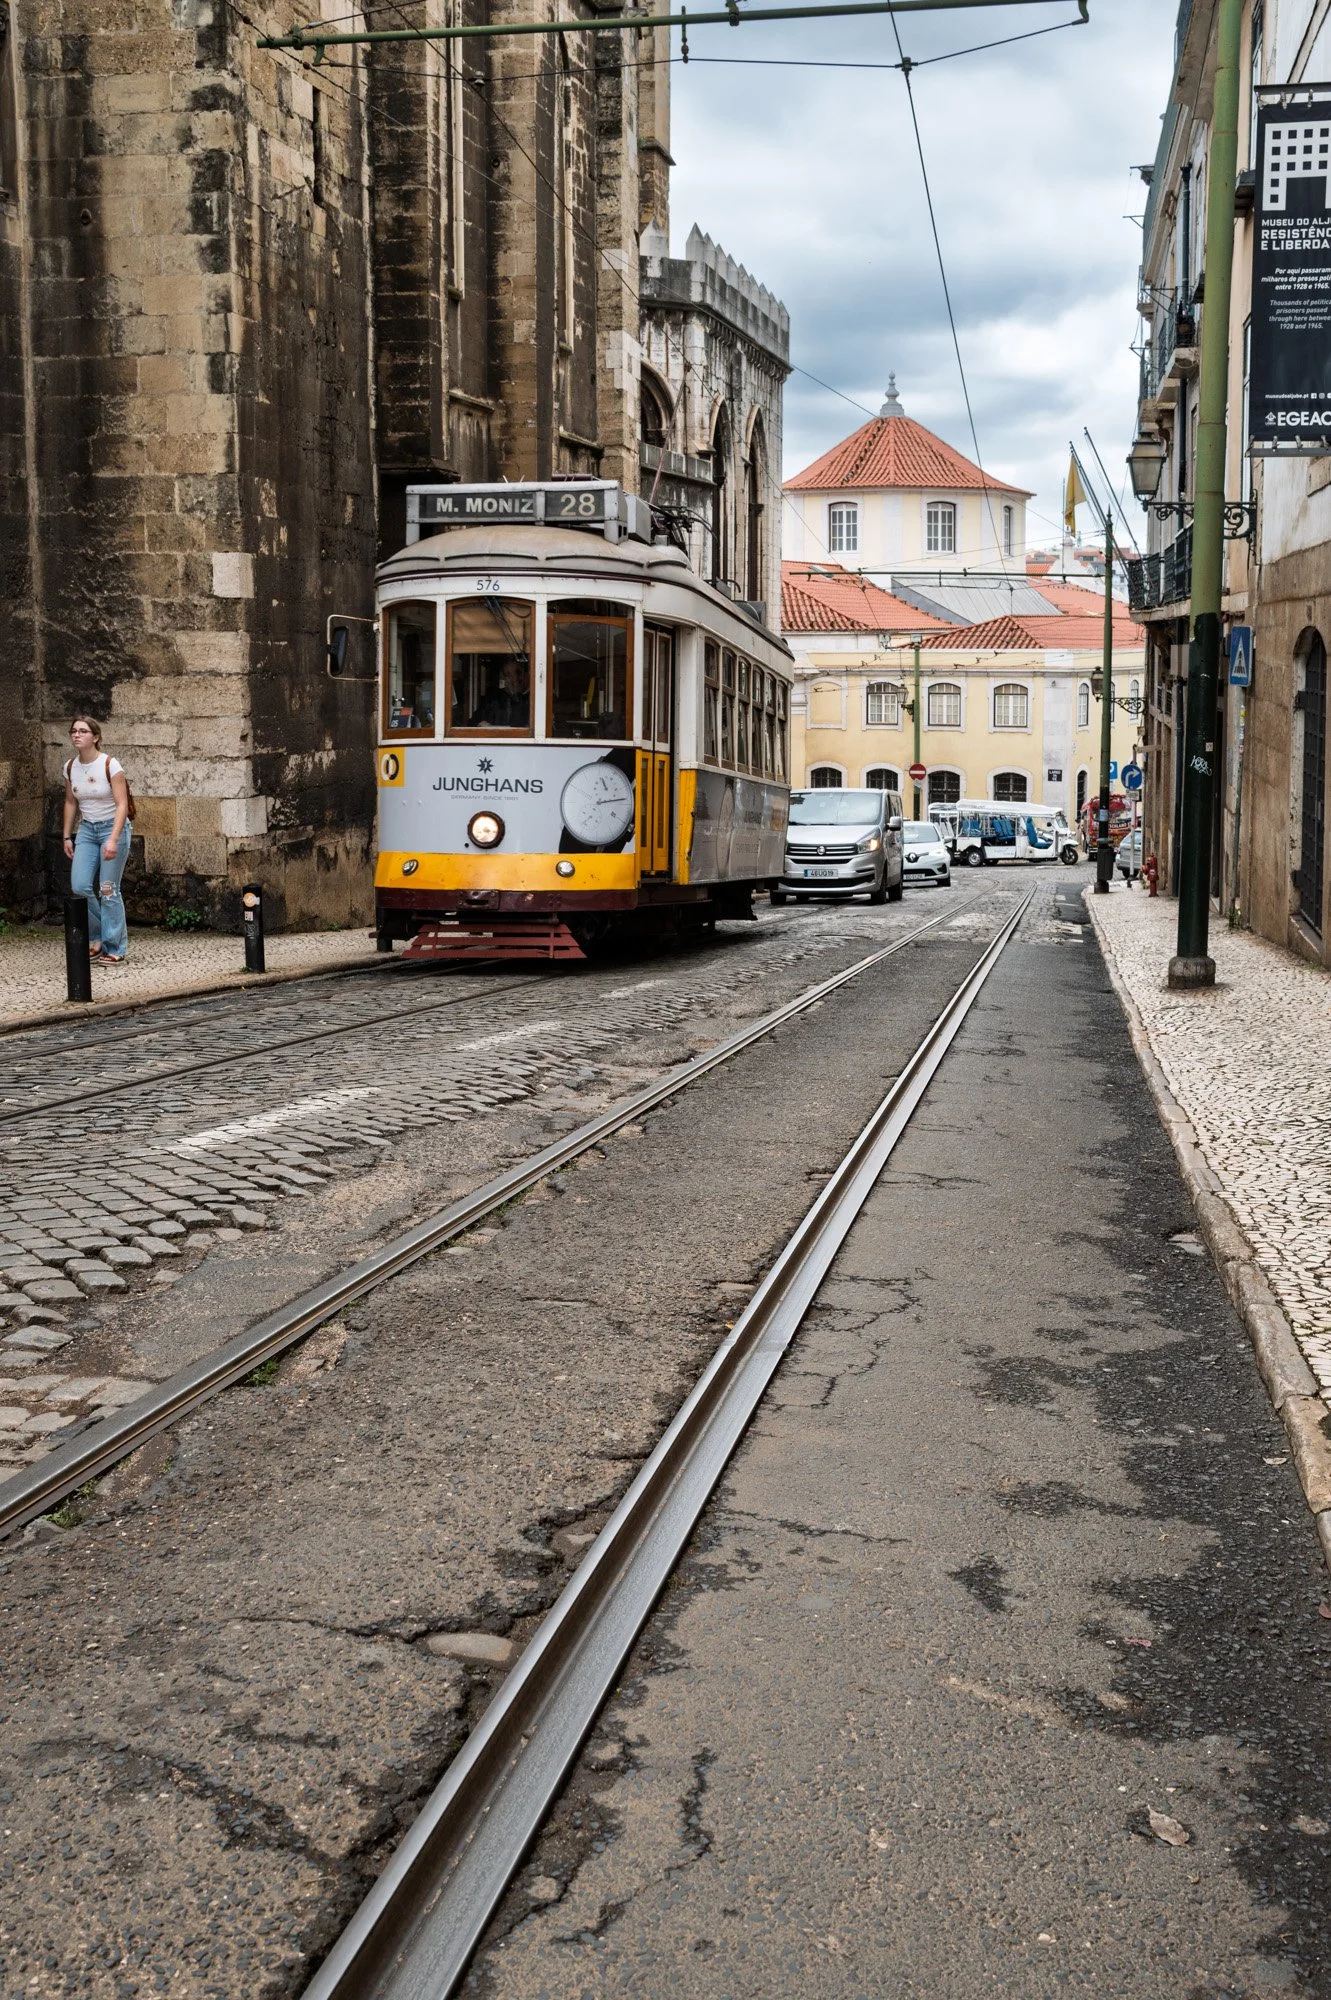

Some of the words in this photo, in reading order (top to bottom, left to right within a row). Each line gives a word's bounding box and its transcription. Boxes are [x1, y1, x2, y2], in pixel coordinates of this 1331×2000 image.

[1297, 218, 1309, 226] DO
[1312, 217, 1331, 225] ALJ
[1261, 226, 1331, 239] RESISTÊNC
[1261, 240, 1268, 250] E
[1272, 239, 1330, 250] LIBERDA
[1306, 306, 1328, 314] passed
[1277, 411, 1331, 426] EGEAC
[436, 497, 459, 513] M.
[465, 497, 534, 514] MONIZ
[560, 493, 596, 516] 28
[476, 579, 500, 592] 576
[432, 777, 544, 794] JUNGHANS
